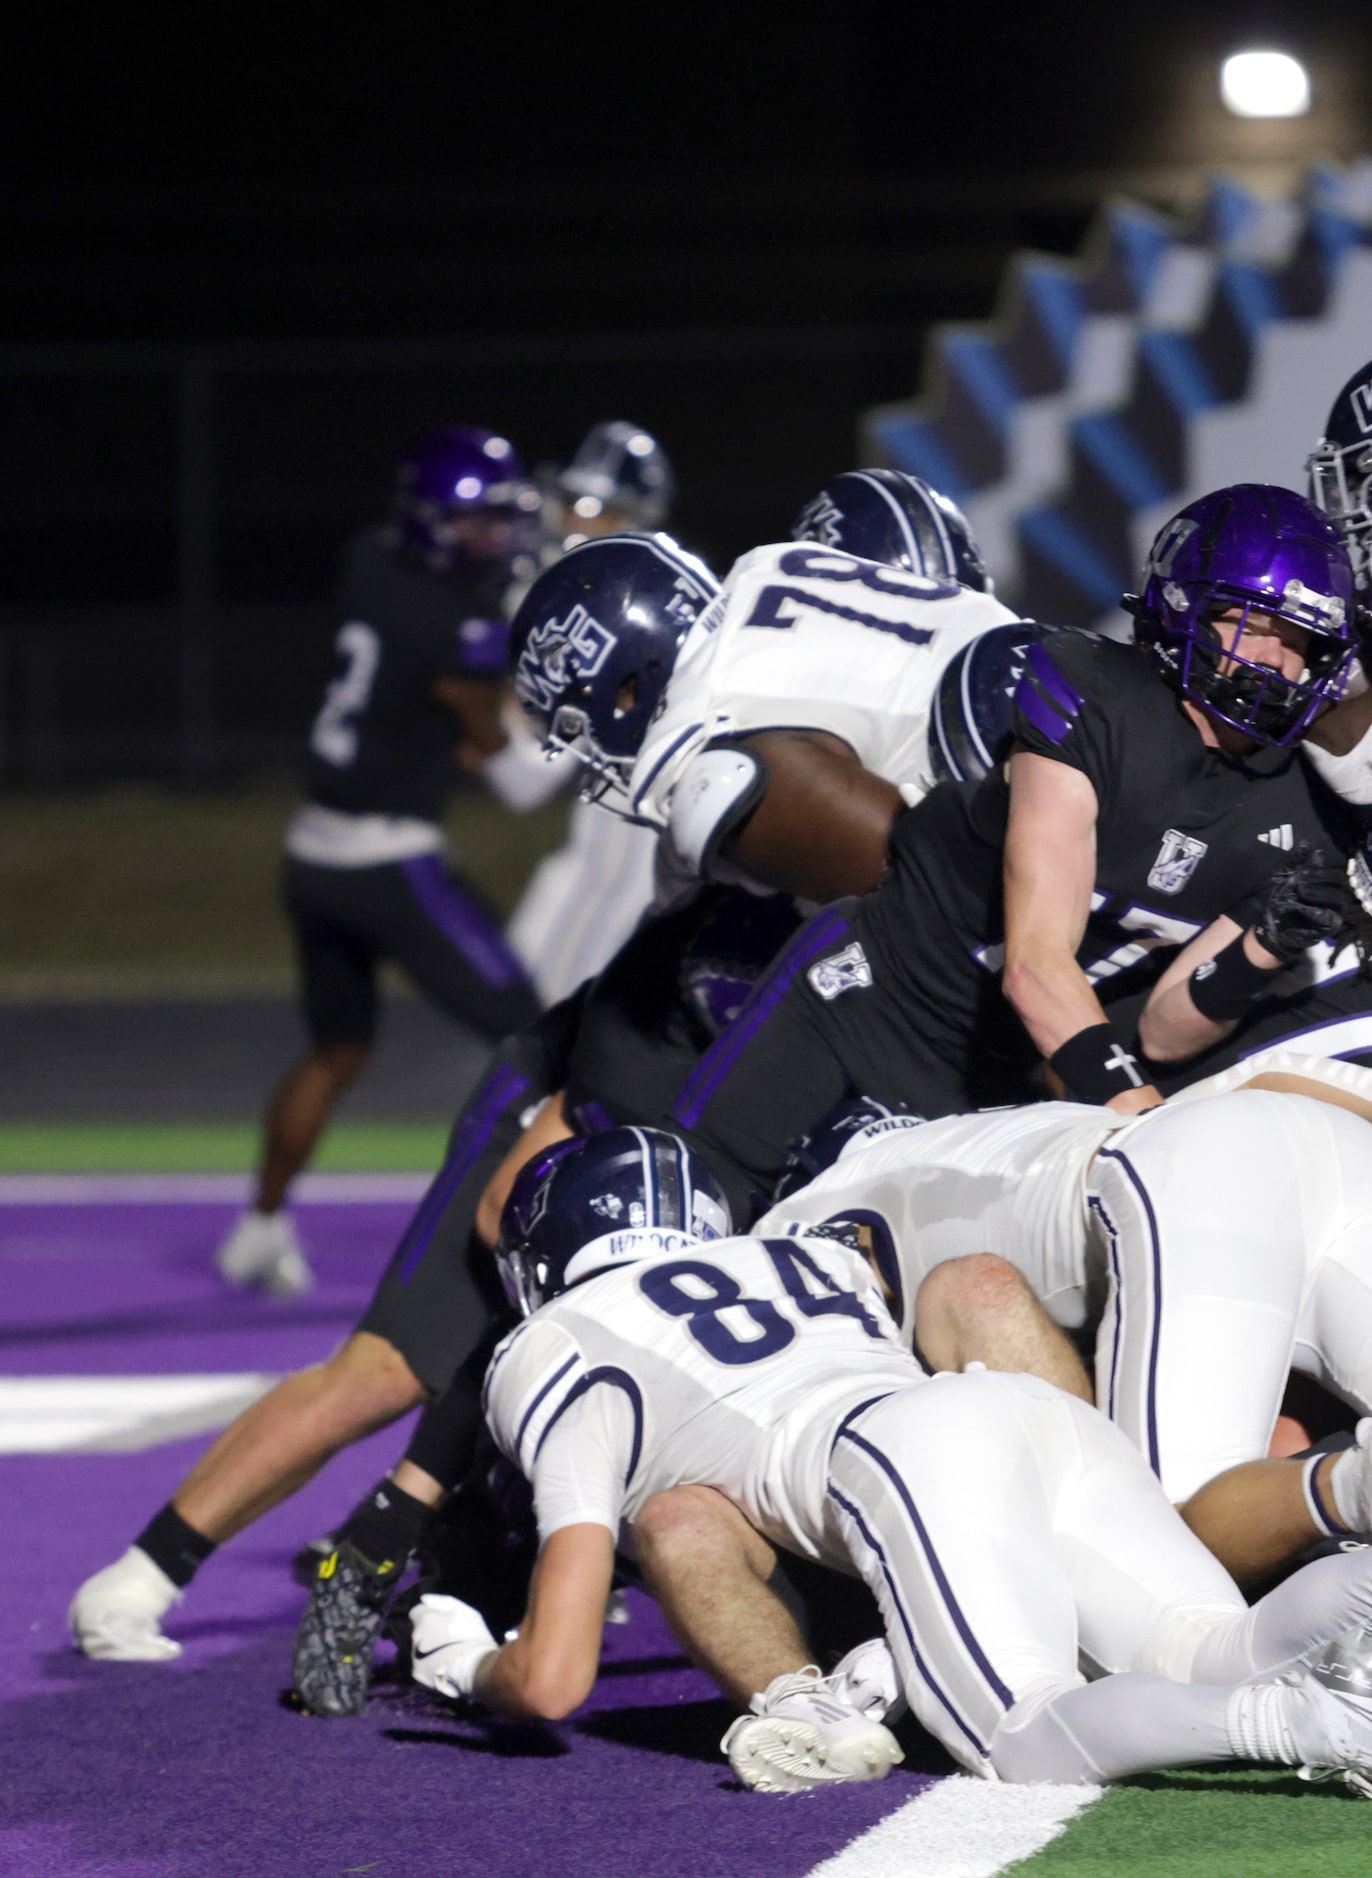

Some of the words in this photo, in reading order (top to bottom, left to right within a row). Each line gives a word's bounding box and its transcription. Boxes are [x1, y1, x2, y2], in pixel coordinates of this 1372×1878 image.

[741, 548, 962, 649] 78
[310, 621, 381, 768] 2
[863, 1118, 922, 1139] WILD
[637, 1235, 892, 1368] 84
